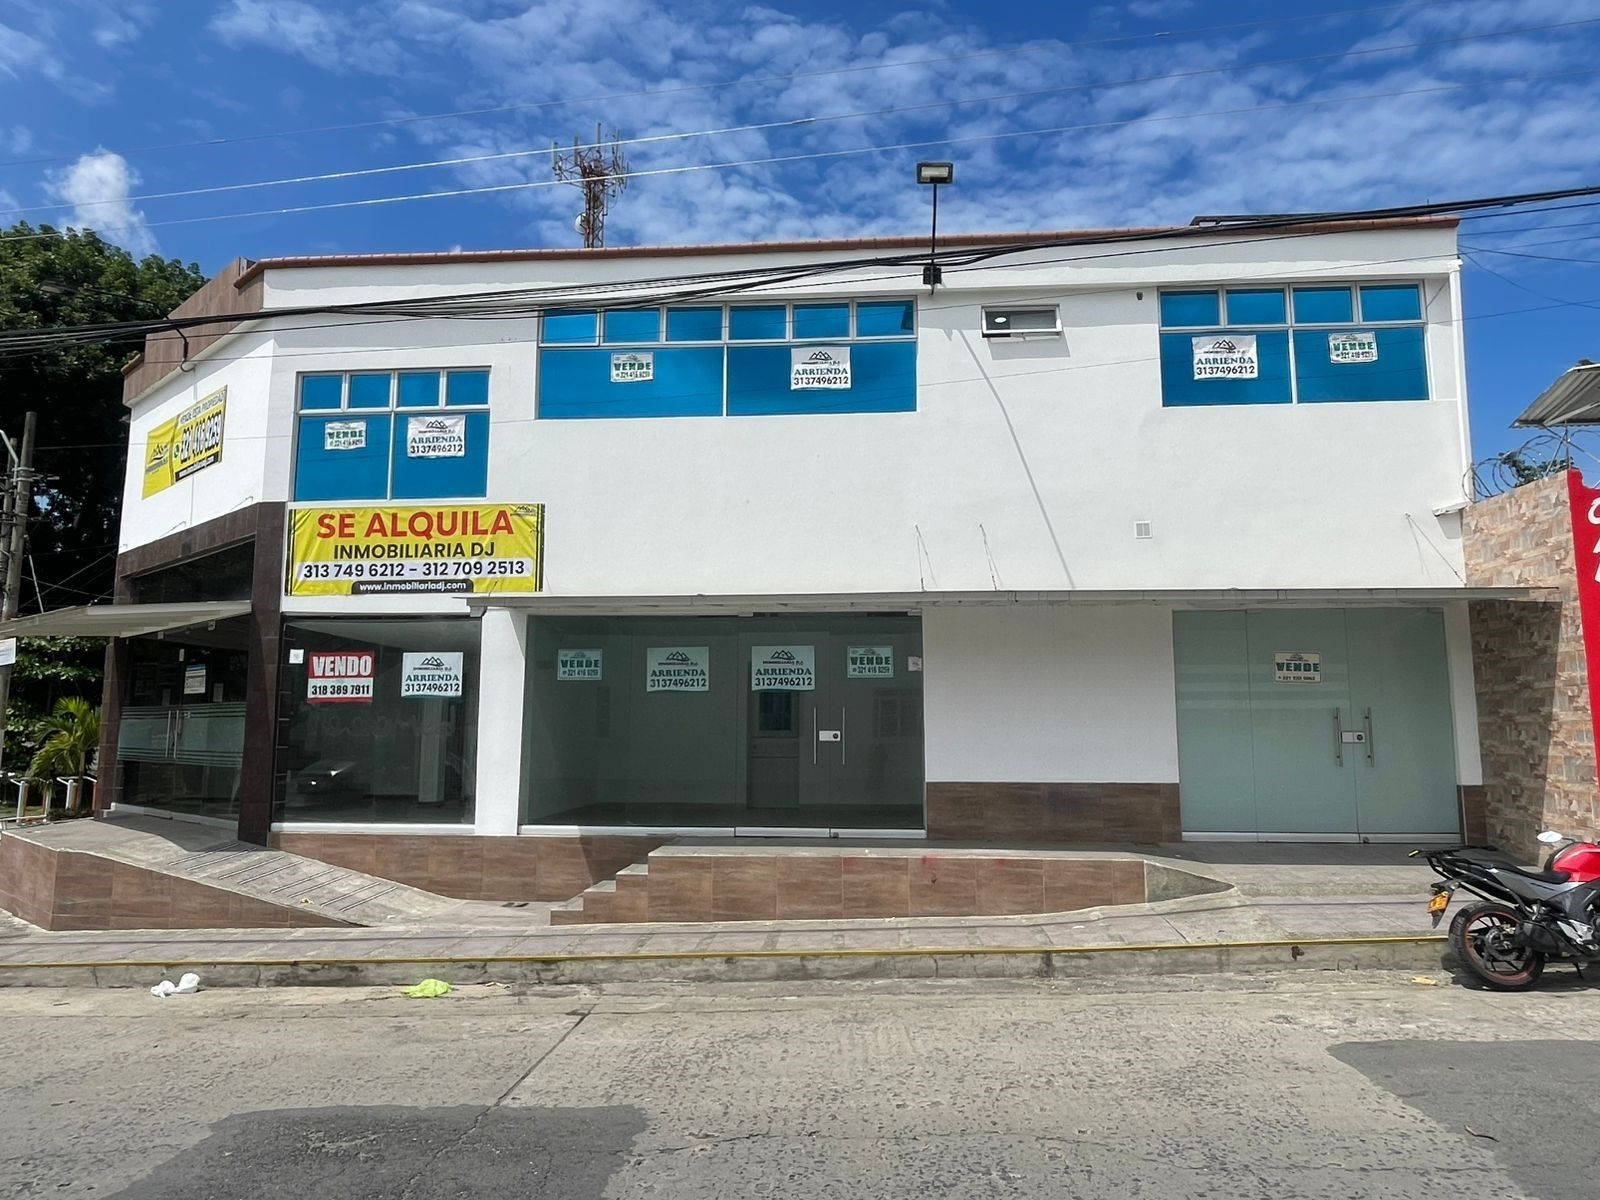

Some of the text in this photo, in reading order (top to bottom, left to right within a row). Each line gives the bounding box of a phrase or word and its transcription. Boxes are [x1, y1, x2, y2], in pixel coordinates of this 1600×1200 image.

[1333, 342, 1375, 351] VENDE
[1196, 357, 1255, 365] ARRIENDA
[614, 362, 652, 371] VENDE
[1196, 366, 1255, 375] 3137496212
[794, 368, 849, 376] ARRIENDA
[793, 376, 849, 385] 3137496212
[328, 430, 364, 439] VENDE
[410, 435, 463, 444] ARRIENDA
[410, 444, 463, 454] 3137496212
[317, 510, 514, 540] SE ALQUILA
[334, 542, 495, 559] INMOBILIARIA DJ
[304, 564, 330, 578] 313
[334, 564, 364, 578] 749
[369, 563, 405, 577] 6212
[422, 562, 449, 576] 312
[453, 561, 483, 575] 709
[487, 560, 525, 575] 2513
[359, 581, 467, 593] www.inmobiliariadj.com
[561, 659, 600, 668] VENDE
[850, 656, 891, 665] VENDE
[312, 655, 372, 677] VENDO
[1276, 662, 1320, 672] VENDE
[650, 669, 706, 677] ARRIENDA
[755, 668, 812, 676] ARRIENDA
[405, 674, 460, 682] ARRIENDA
[755, 677, 813, 686] 3137496212
[405, 683, 460, 692] 3137496212
[650, 678, 707, 688] 3137496212
[311, 685, 370, 695] 318 389 7911
